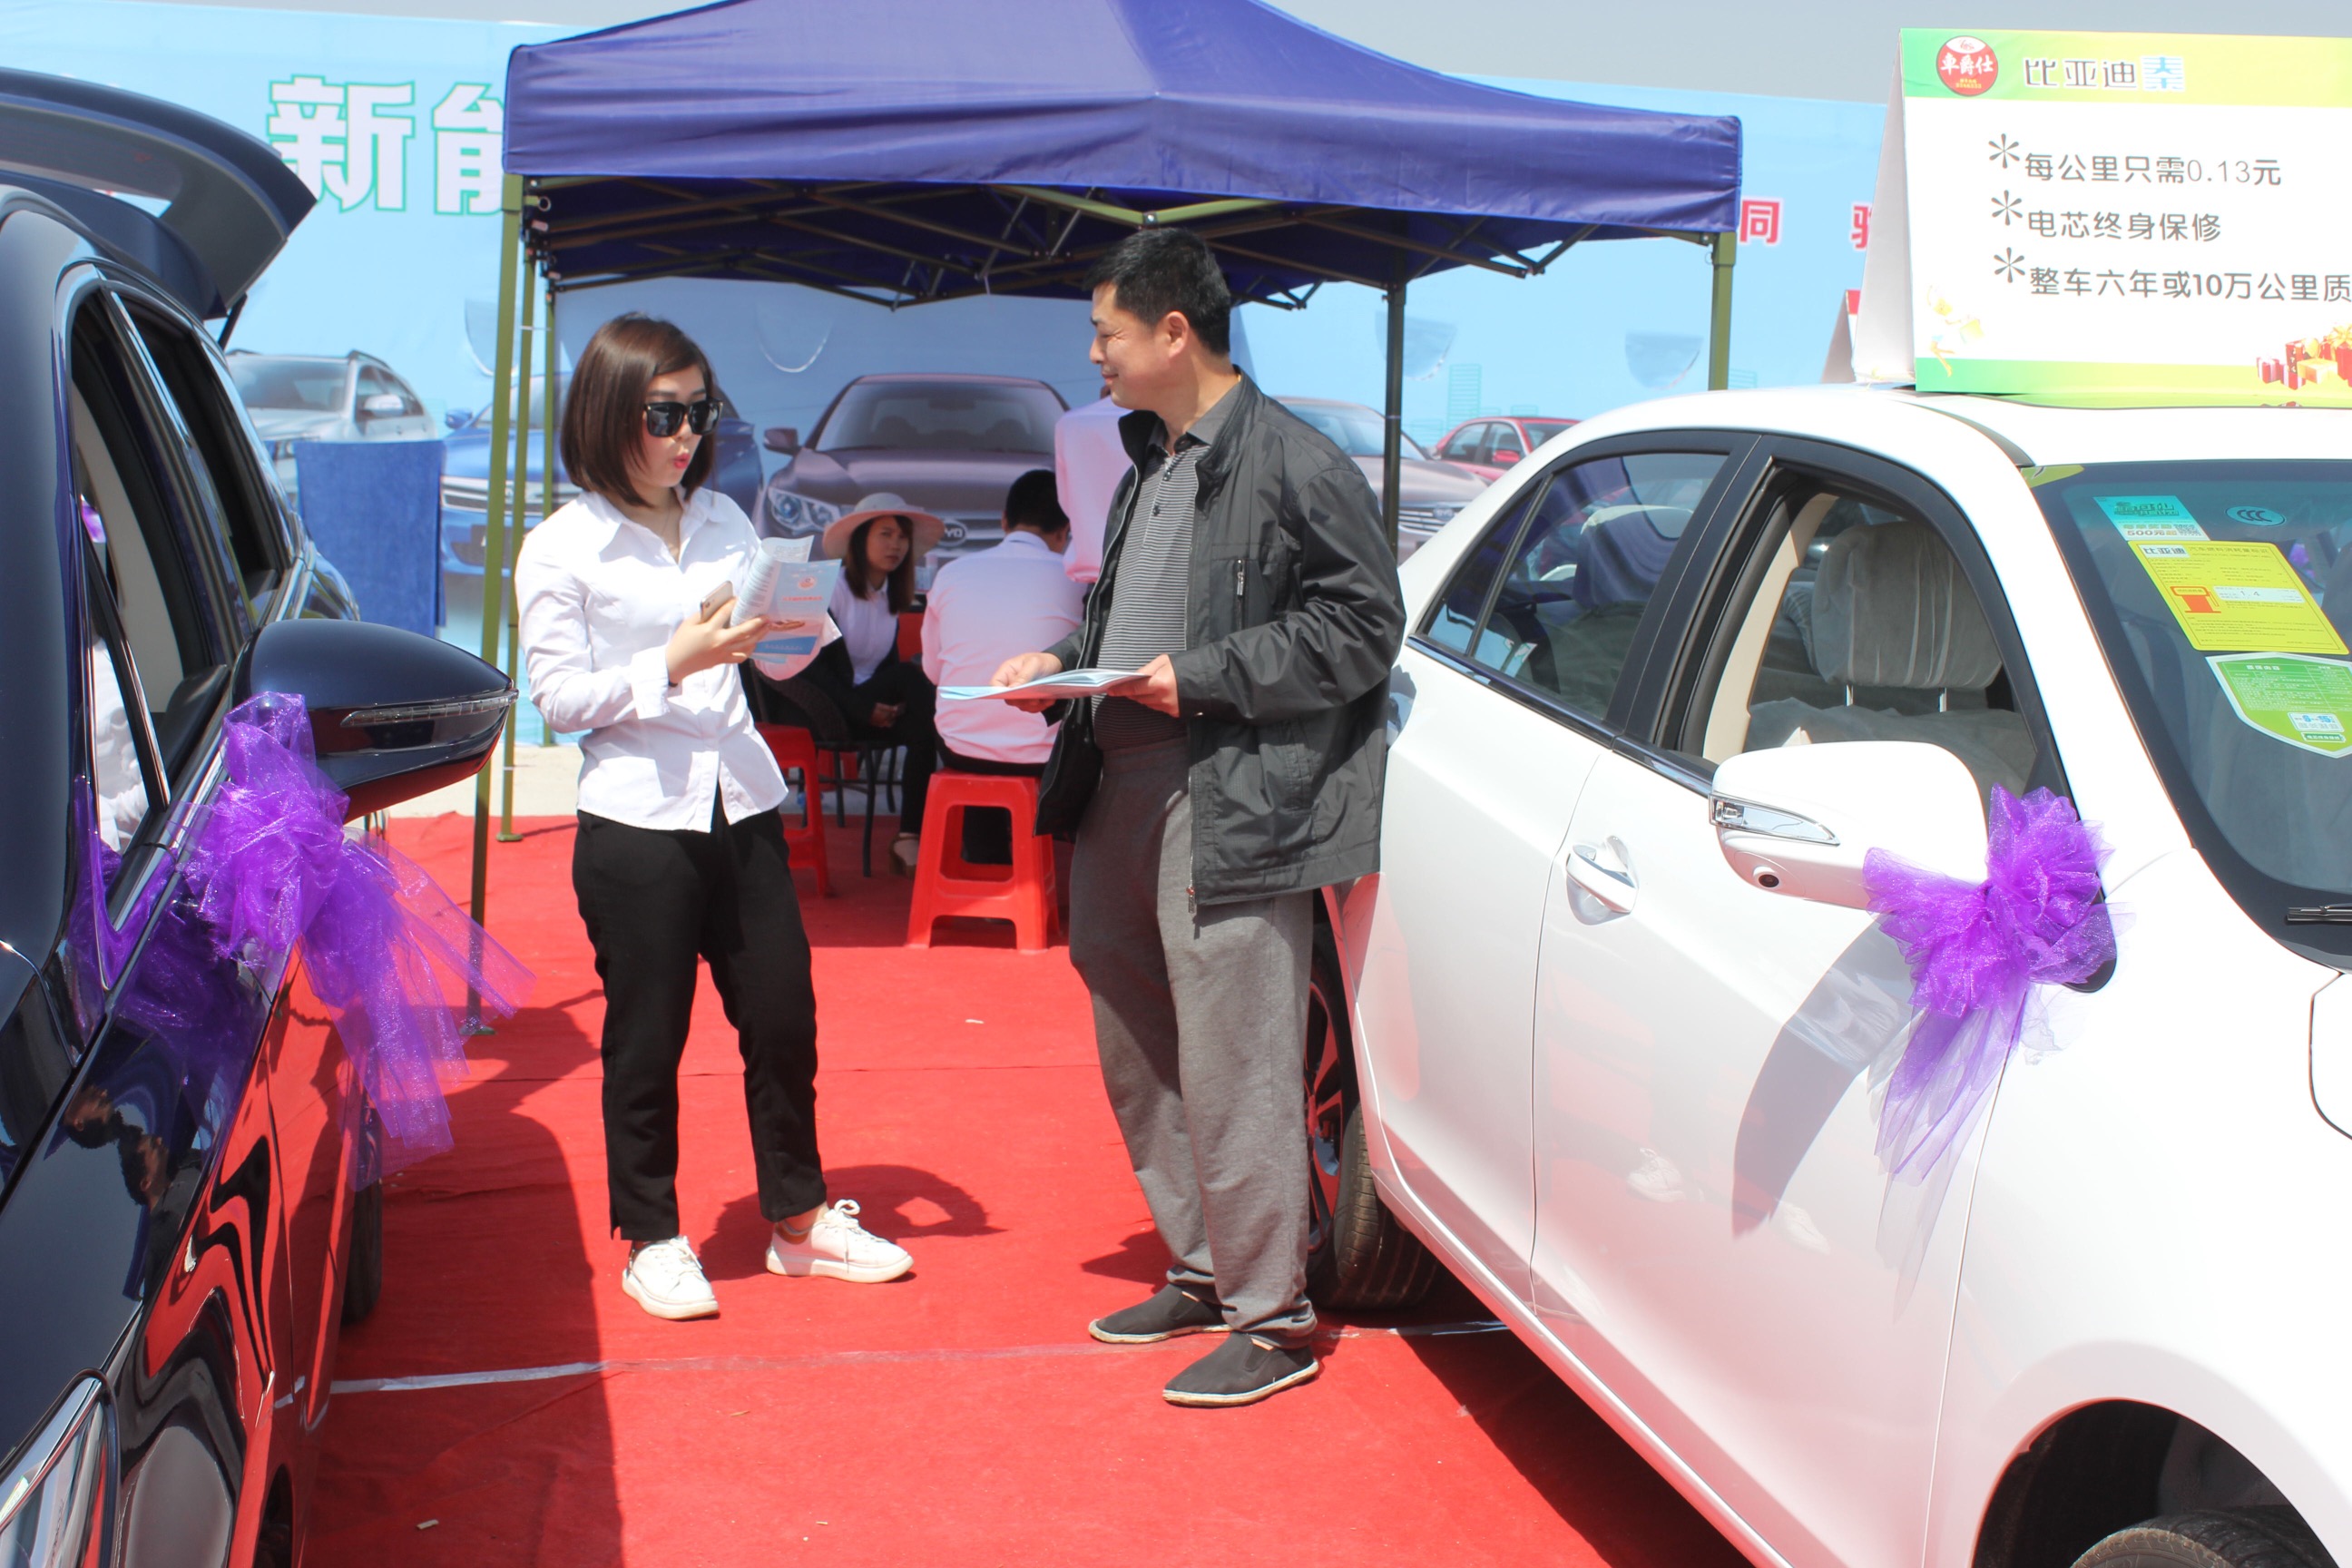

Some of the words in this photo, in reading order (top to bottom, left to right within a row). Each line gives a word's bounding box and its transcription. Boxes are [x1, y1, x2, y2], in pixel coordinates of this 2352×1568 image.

[2024, 152, 2282, 186] 每公里只需0.13元
[1740, 199, 1780, 243] 同
[2028, 211, 2221, 242] 电芯终身保修
[2030, 268, 2352, 302] 整车六年或10万公里质
[2142, 547, 2187, 555] 比亚迪
